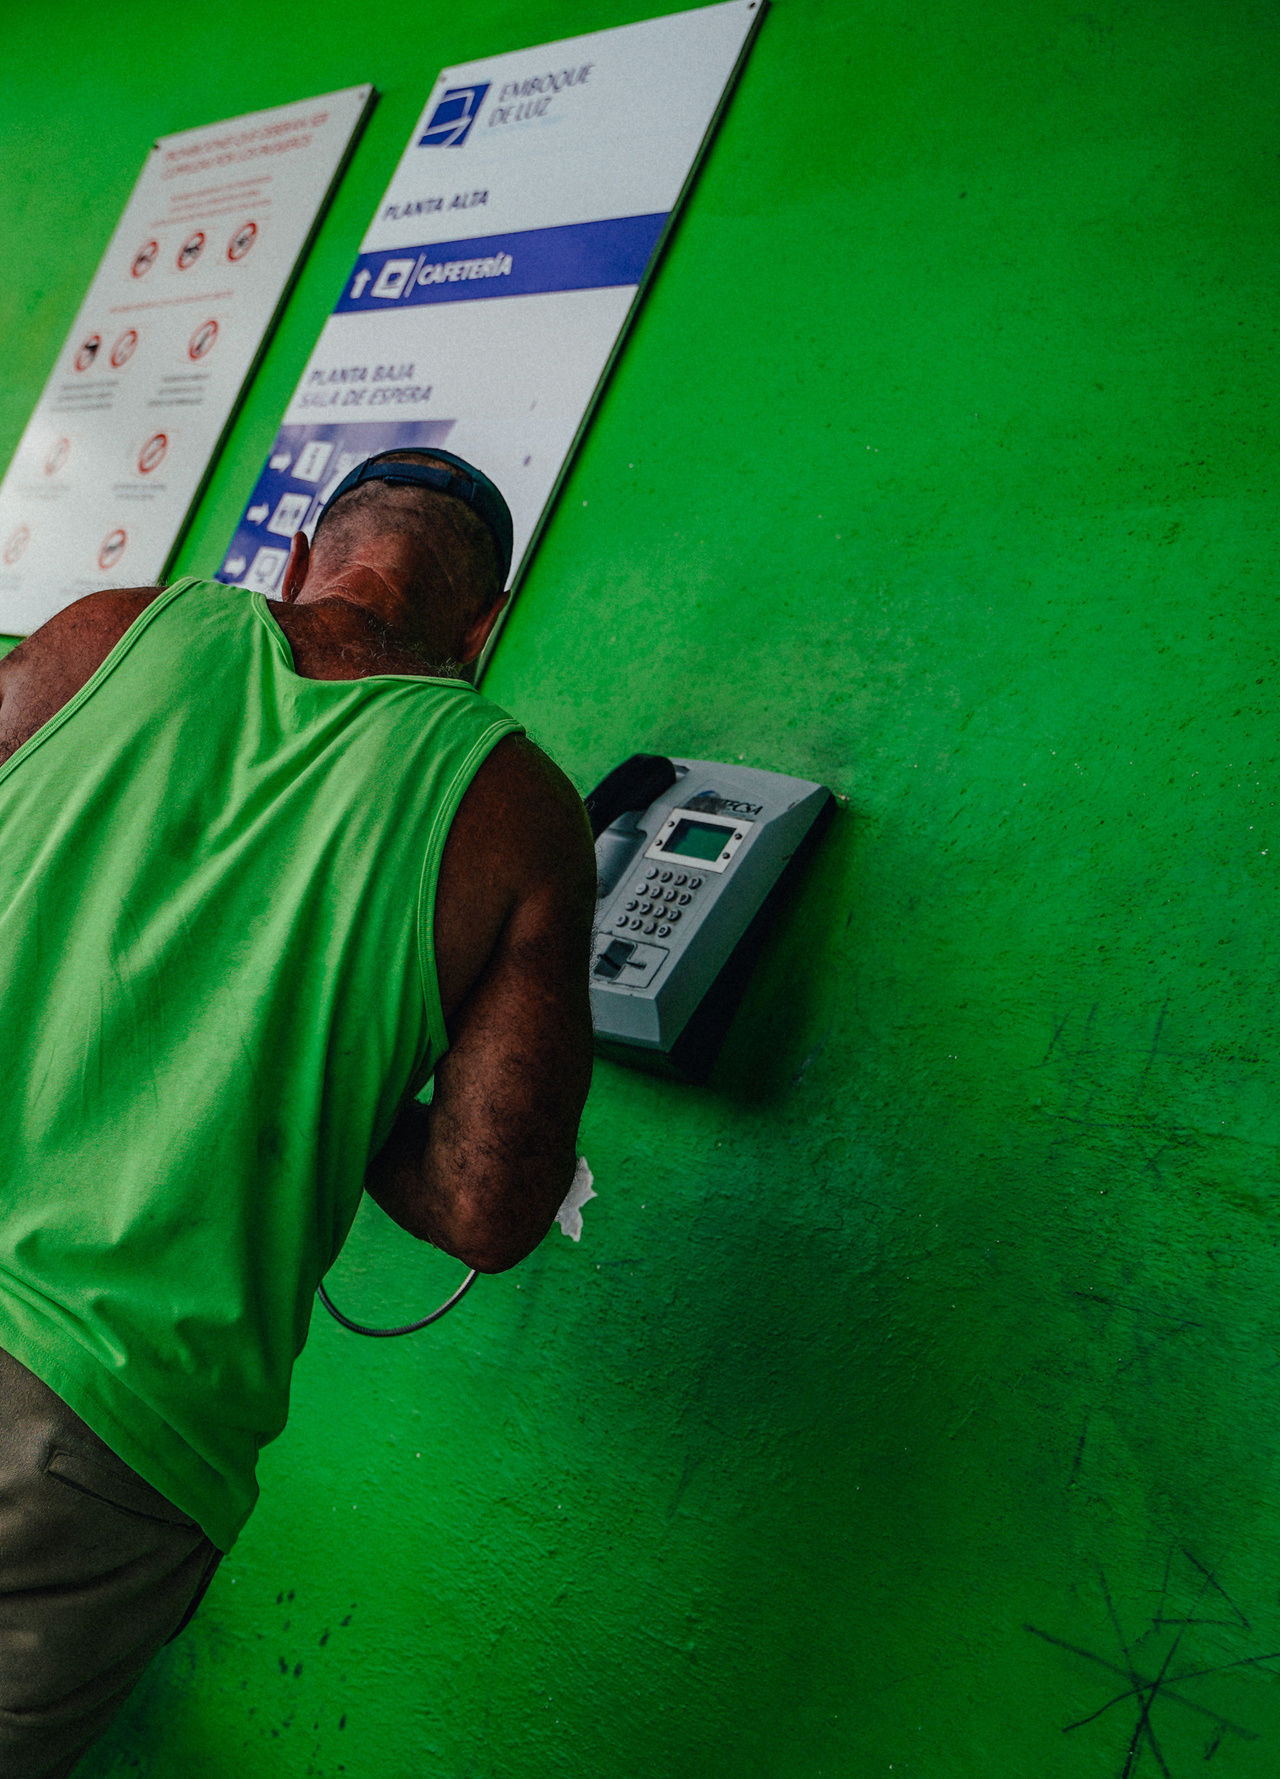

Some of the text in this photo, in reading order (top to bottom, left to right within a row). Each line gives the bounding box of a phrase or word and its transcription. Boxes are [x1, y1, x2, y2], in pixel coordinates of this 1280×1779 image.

[499, 62, 595, 102] EMBOQUE
[488, 97, 552, 127] DE LUZ
[383, 190, 489, 220] PLANTA ALTA
[417, 251, 513, 286] CAFETERÍA
[310, 363, 415, 385] PLANTA BAJA
[300, 385, 433, 408] SALA DE ESPERA
